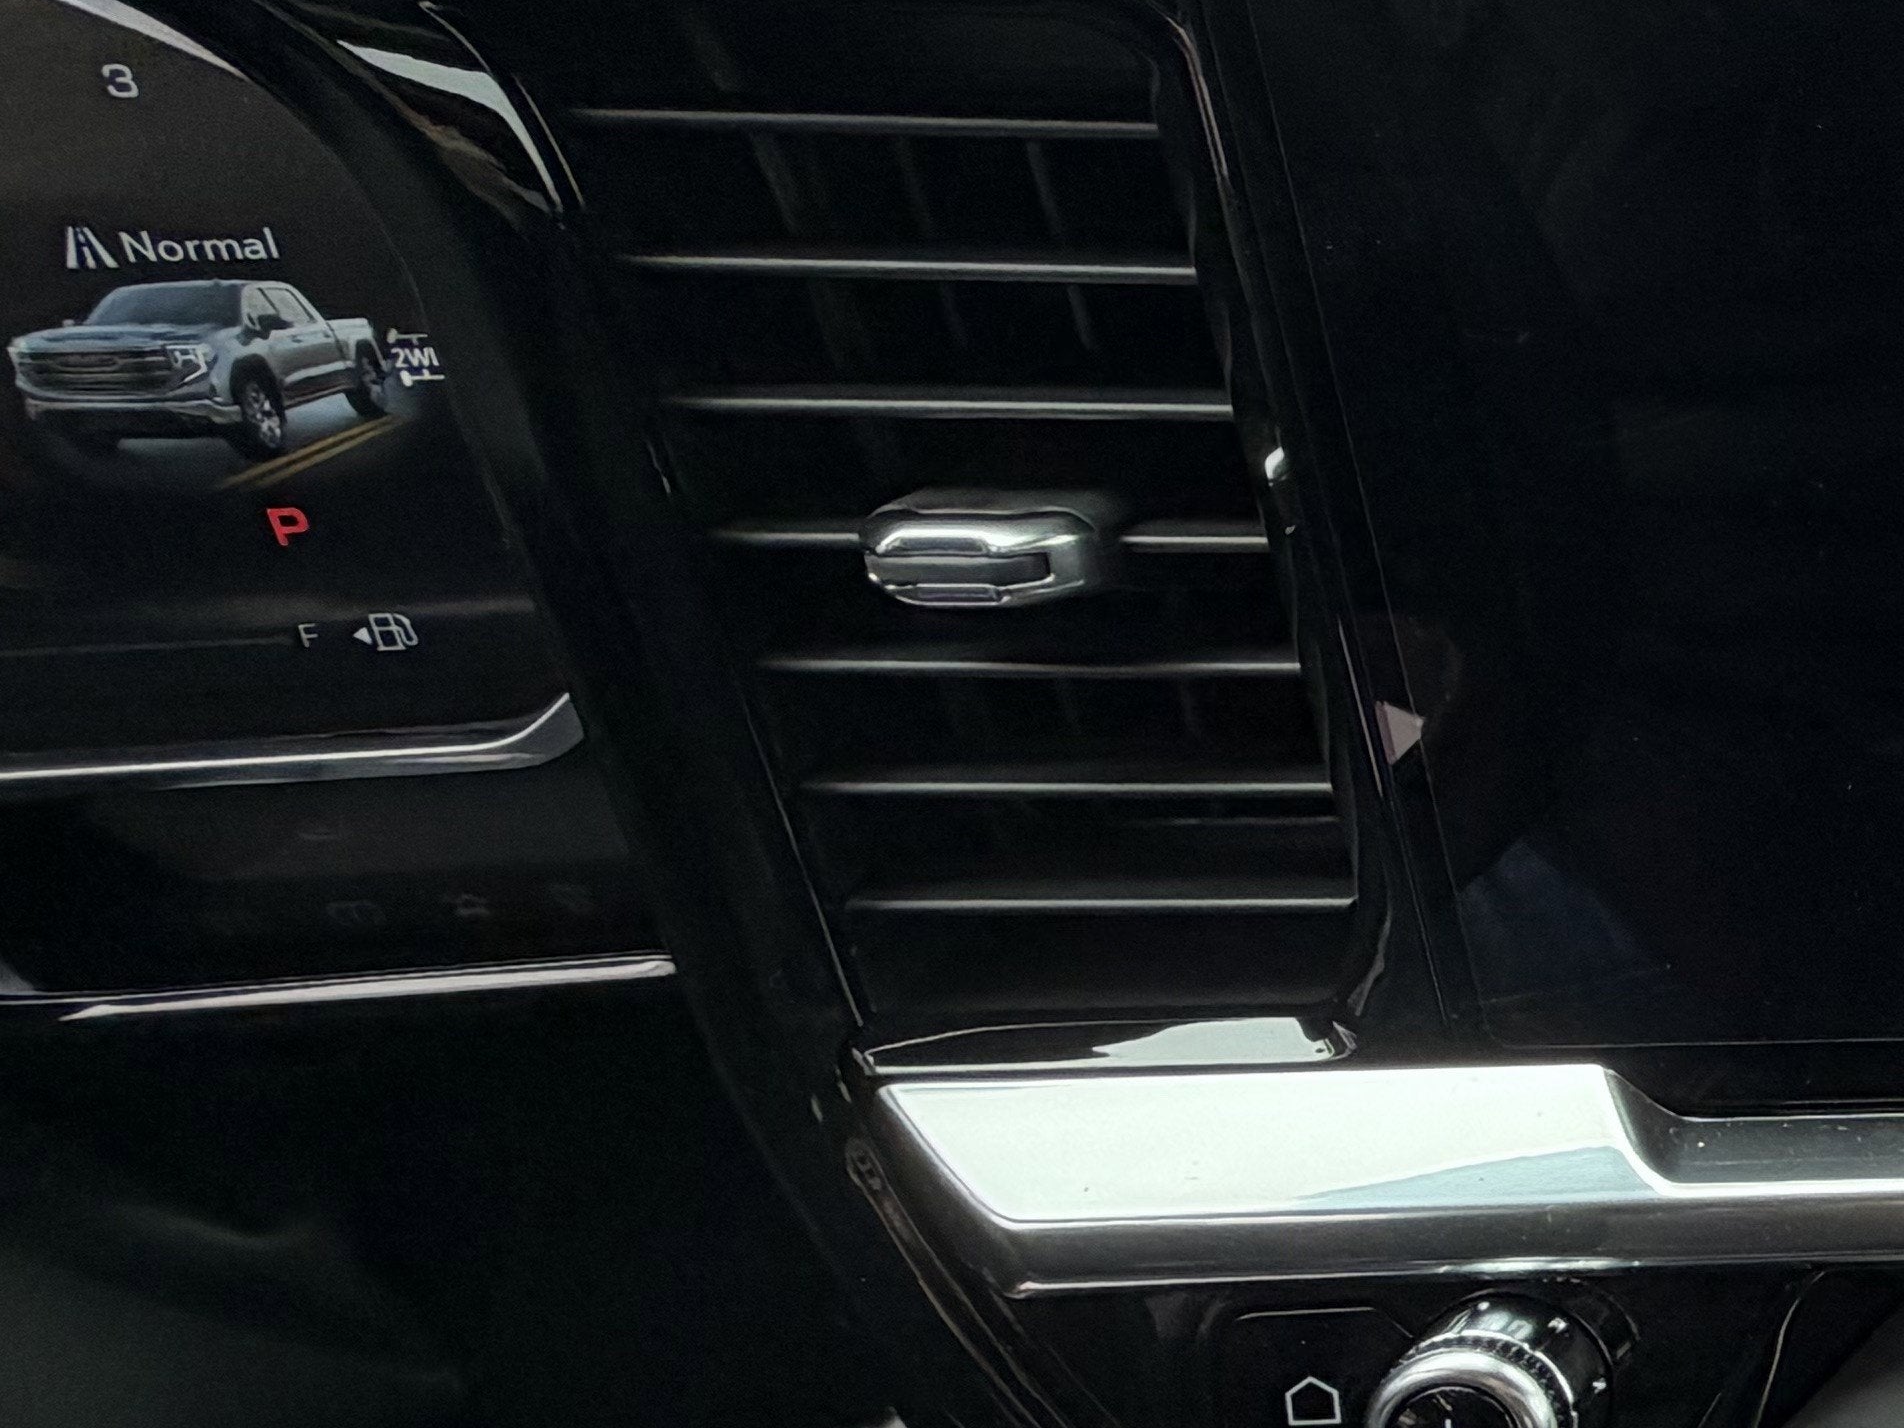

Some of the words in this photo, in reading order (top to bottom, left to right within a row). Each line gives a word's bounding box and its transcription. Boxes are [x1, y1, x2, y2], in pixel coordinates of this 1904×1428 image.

[102, 63, 139, 98] 3
[119, 226, 280, 265] Normal
[390, 346, 440, 369] 2W
[266, 507, 310, 547] P
[298, 623, 319, 648] F
